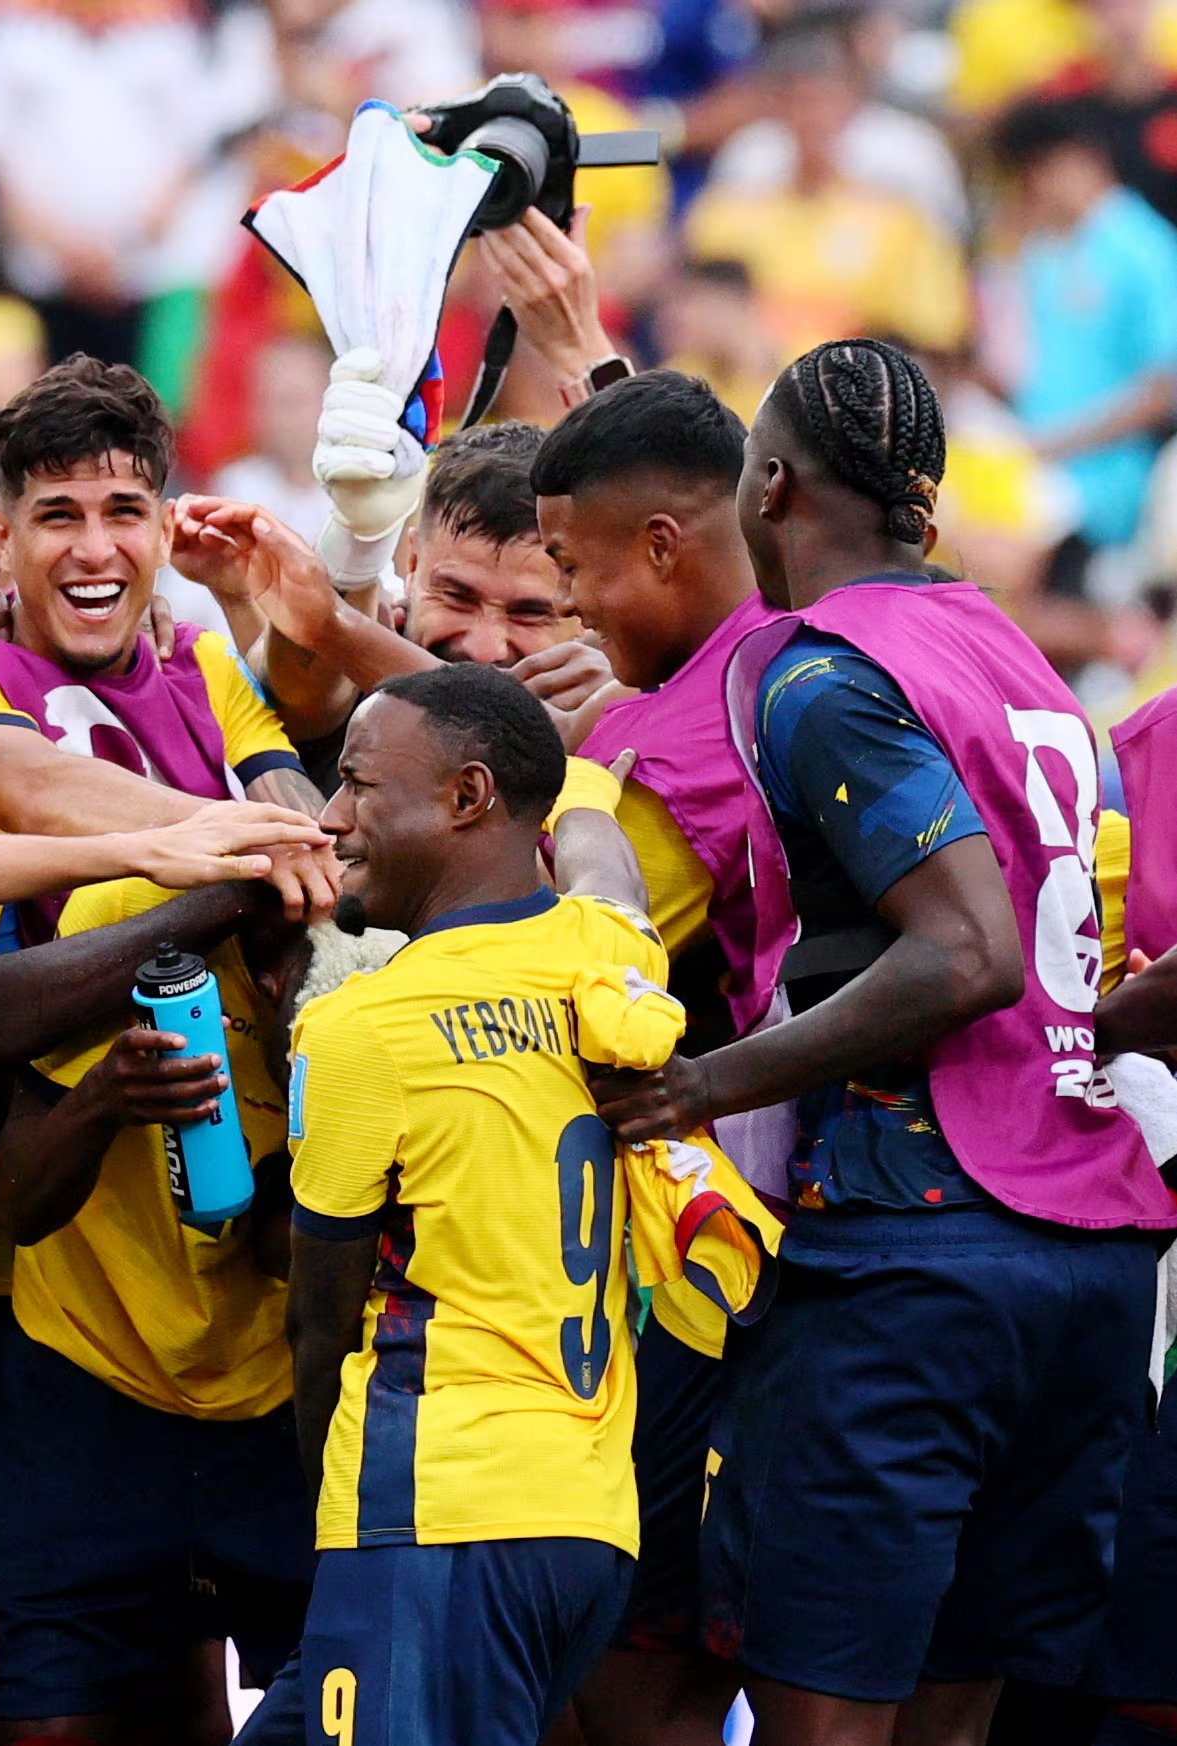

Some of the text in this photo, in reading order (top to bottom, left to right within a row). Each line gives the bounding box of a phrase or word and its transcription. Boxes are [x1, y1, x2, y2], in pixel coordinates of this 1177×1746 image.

[190, 1005, 202, 1019] 6
[429, 997, 562, 1064] YEBOAH
[554, 1113, 618, 1400] 9
